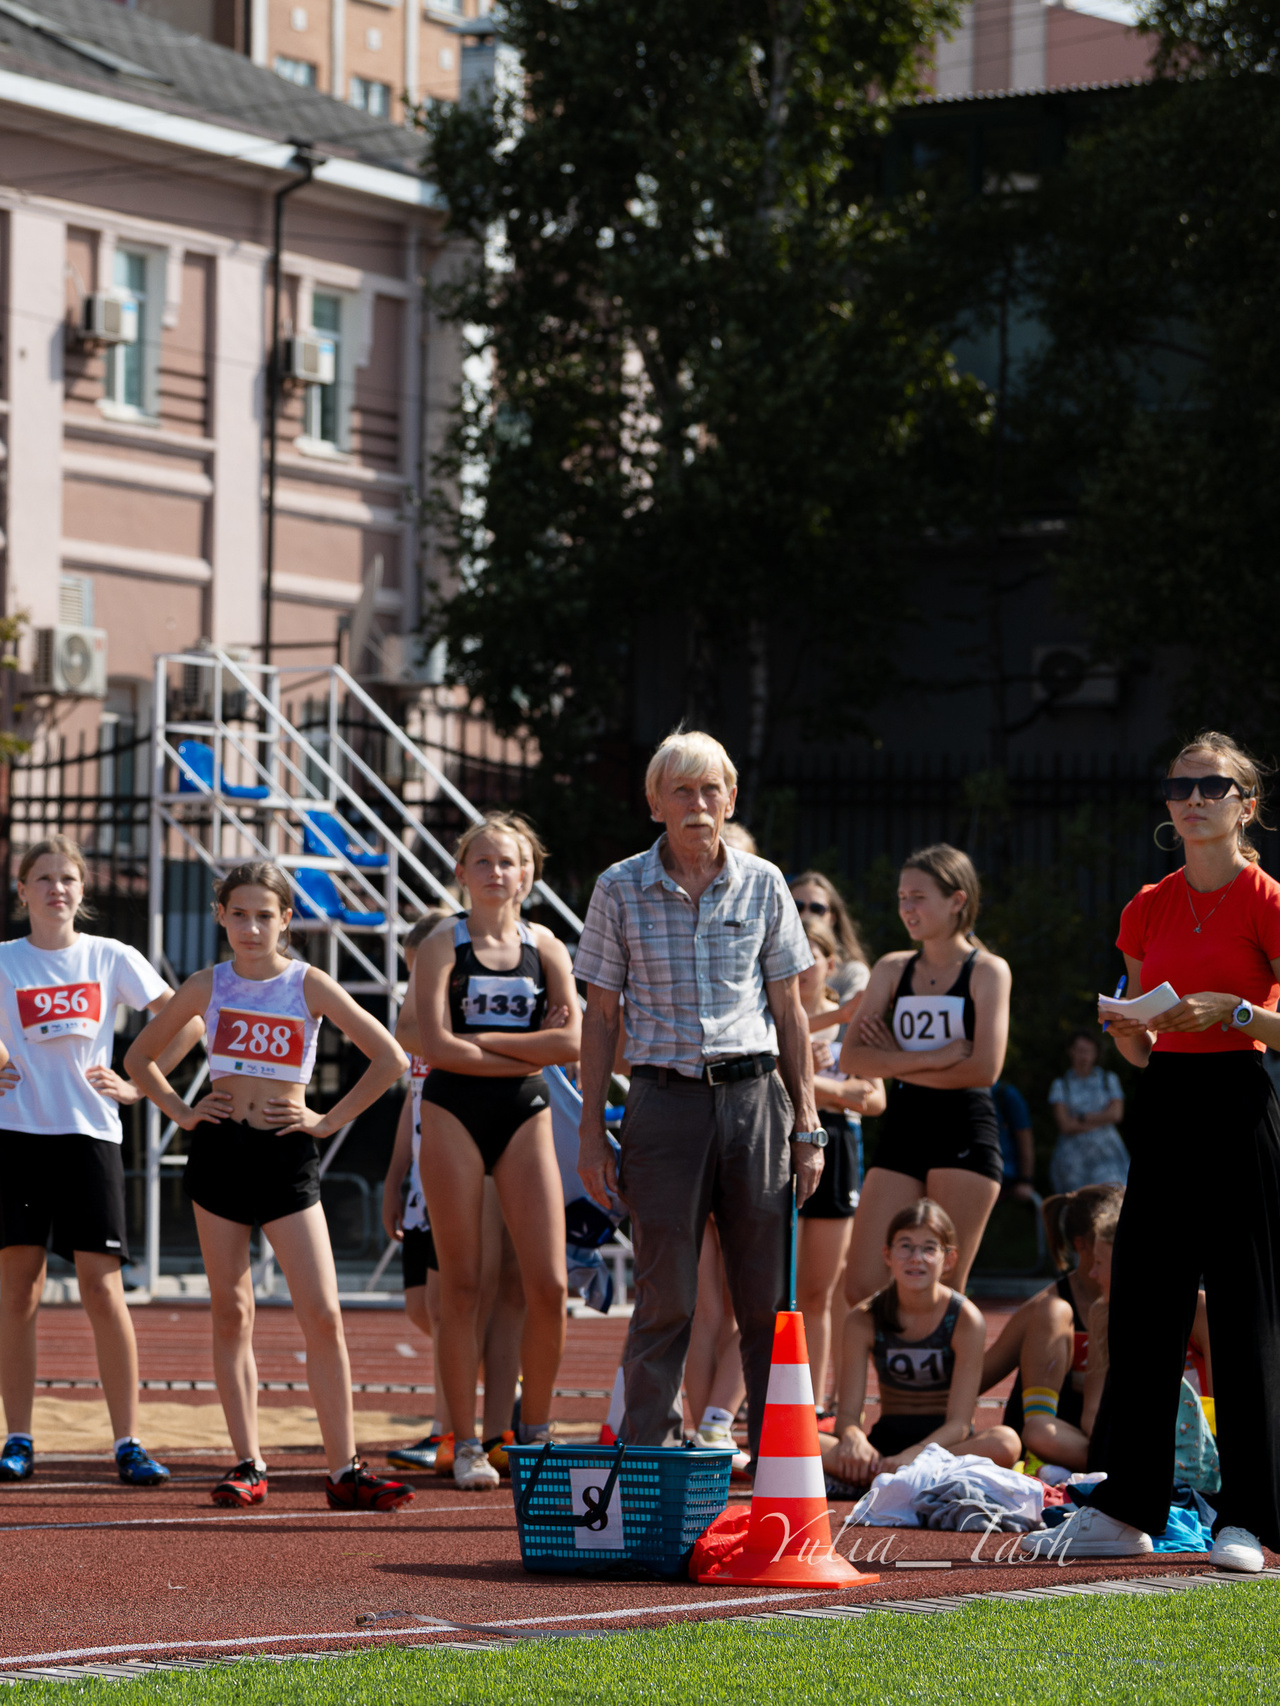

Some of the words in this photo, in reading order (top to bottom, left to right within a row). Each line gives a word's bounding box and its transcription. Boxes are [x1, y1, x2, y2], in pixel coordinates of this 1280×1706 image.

[33, 987, 90, 1018] 956
[473, 993, 529, 1018] 133
[227, 1019, 292, 1058] 288
[900, 1010, 952, 1040] 021
[888, 1353, 941, 1382] 91
